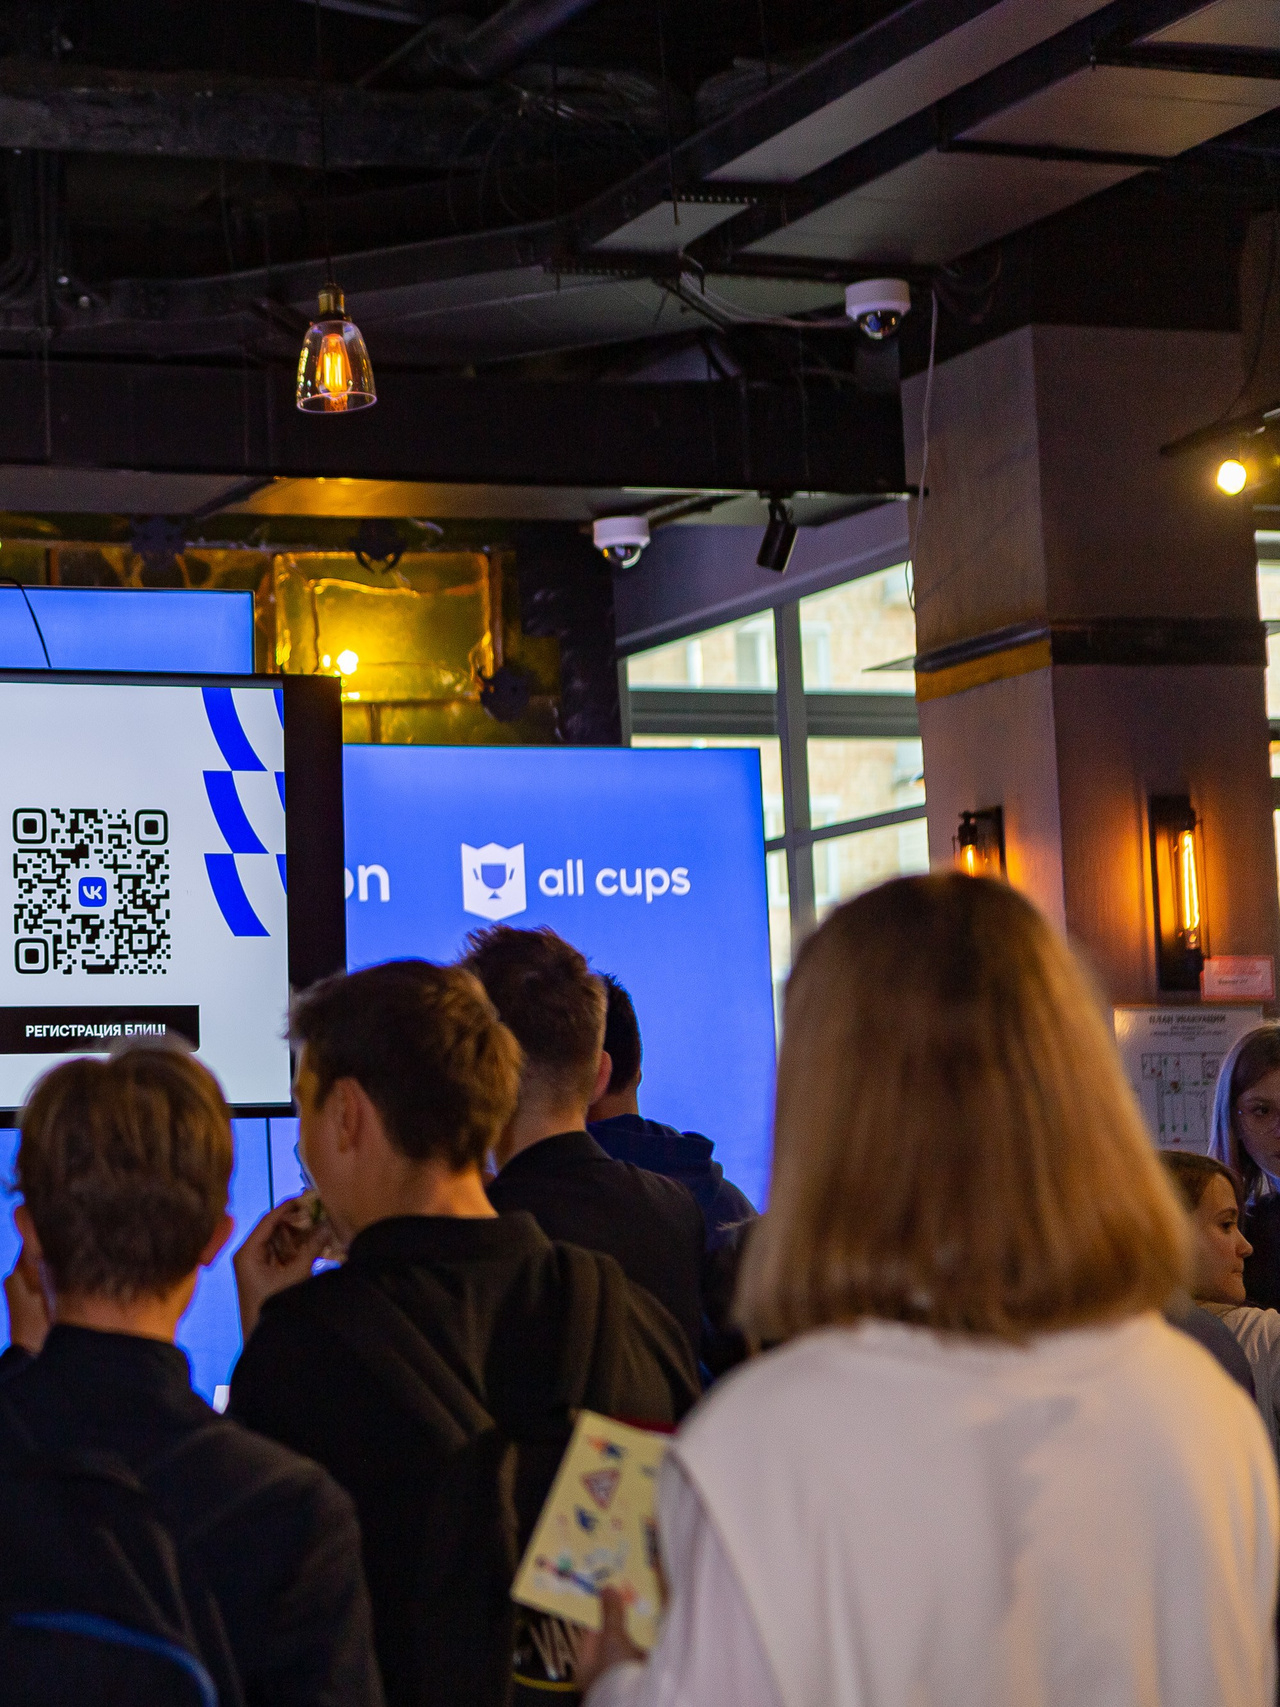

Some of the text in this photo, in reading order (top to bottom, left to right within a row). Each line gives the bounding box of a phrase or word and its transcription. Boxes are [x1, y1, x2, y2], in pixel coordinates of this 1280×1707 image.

[538, 858, 692, 904] all cups
[25, 1023, 166, 1038] РЕГИСТРАЦИЯ БЛИЦ!
